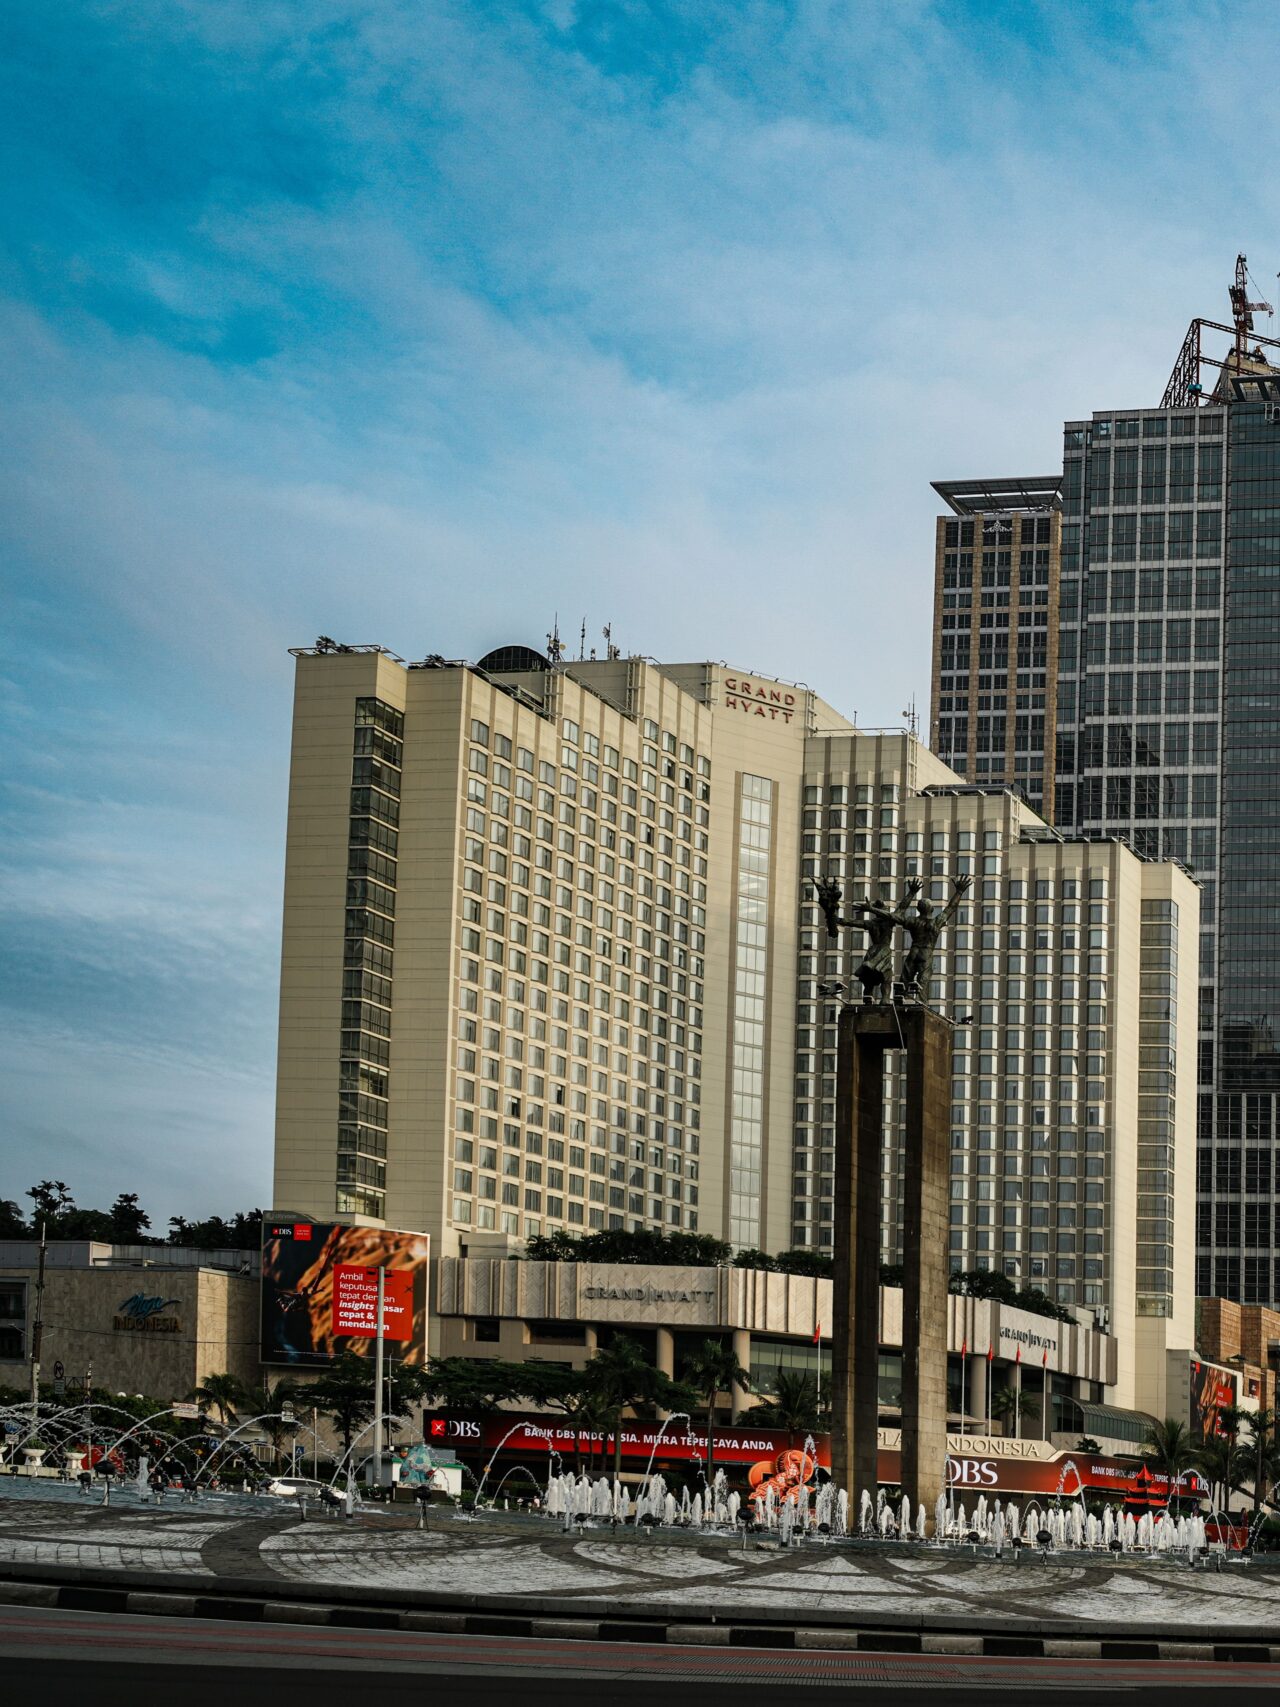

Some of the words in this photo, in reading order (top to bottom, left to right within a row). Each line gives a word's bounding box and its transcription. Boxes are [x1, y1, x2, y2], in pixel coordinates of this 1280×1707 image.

[725, 678, 796, 706] GRAND
[726, 696, 793, 724] HYATT
[339, 1272, 364, 1281] Ambil
[339, 1282, 378, 1292] keputusa
[585, 1287, 647, 1301] GRAND
[653, 1289, 715, 1304] HYATT
[339, 1292, 360, 1300] tepat
[362, 1293, 395, 1303] denan
[339, 1301, 375, 1311] insights
[376, 1304, 404, 1314] asar
[339, 1311, 365, 1320] cepat
[366, 1312, 375, 1320] &
[113, 1315, 183, 1333] INDONESIA
[1000, 1326, 1028, 1344] GRAND
[1031, 1334, 1057, 1351] HYATT
[449, 1420, 481, 1438] DBS
[524, 1427, 554, 1438] BANK
[556, 1430, 576, 1440] DBS
[578, 1430, 641, 1443] INDONSIA.
[643, 1434, 678, 1446] MITRA
[741, 1440, 774, 1451] ANDA
[946, 1436, 1040, 1459] NDONESIA
[1091, 1465, 1105, 1475] BANK
